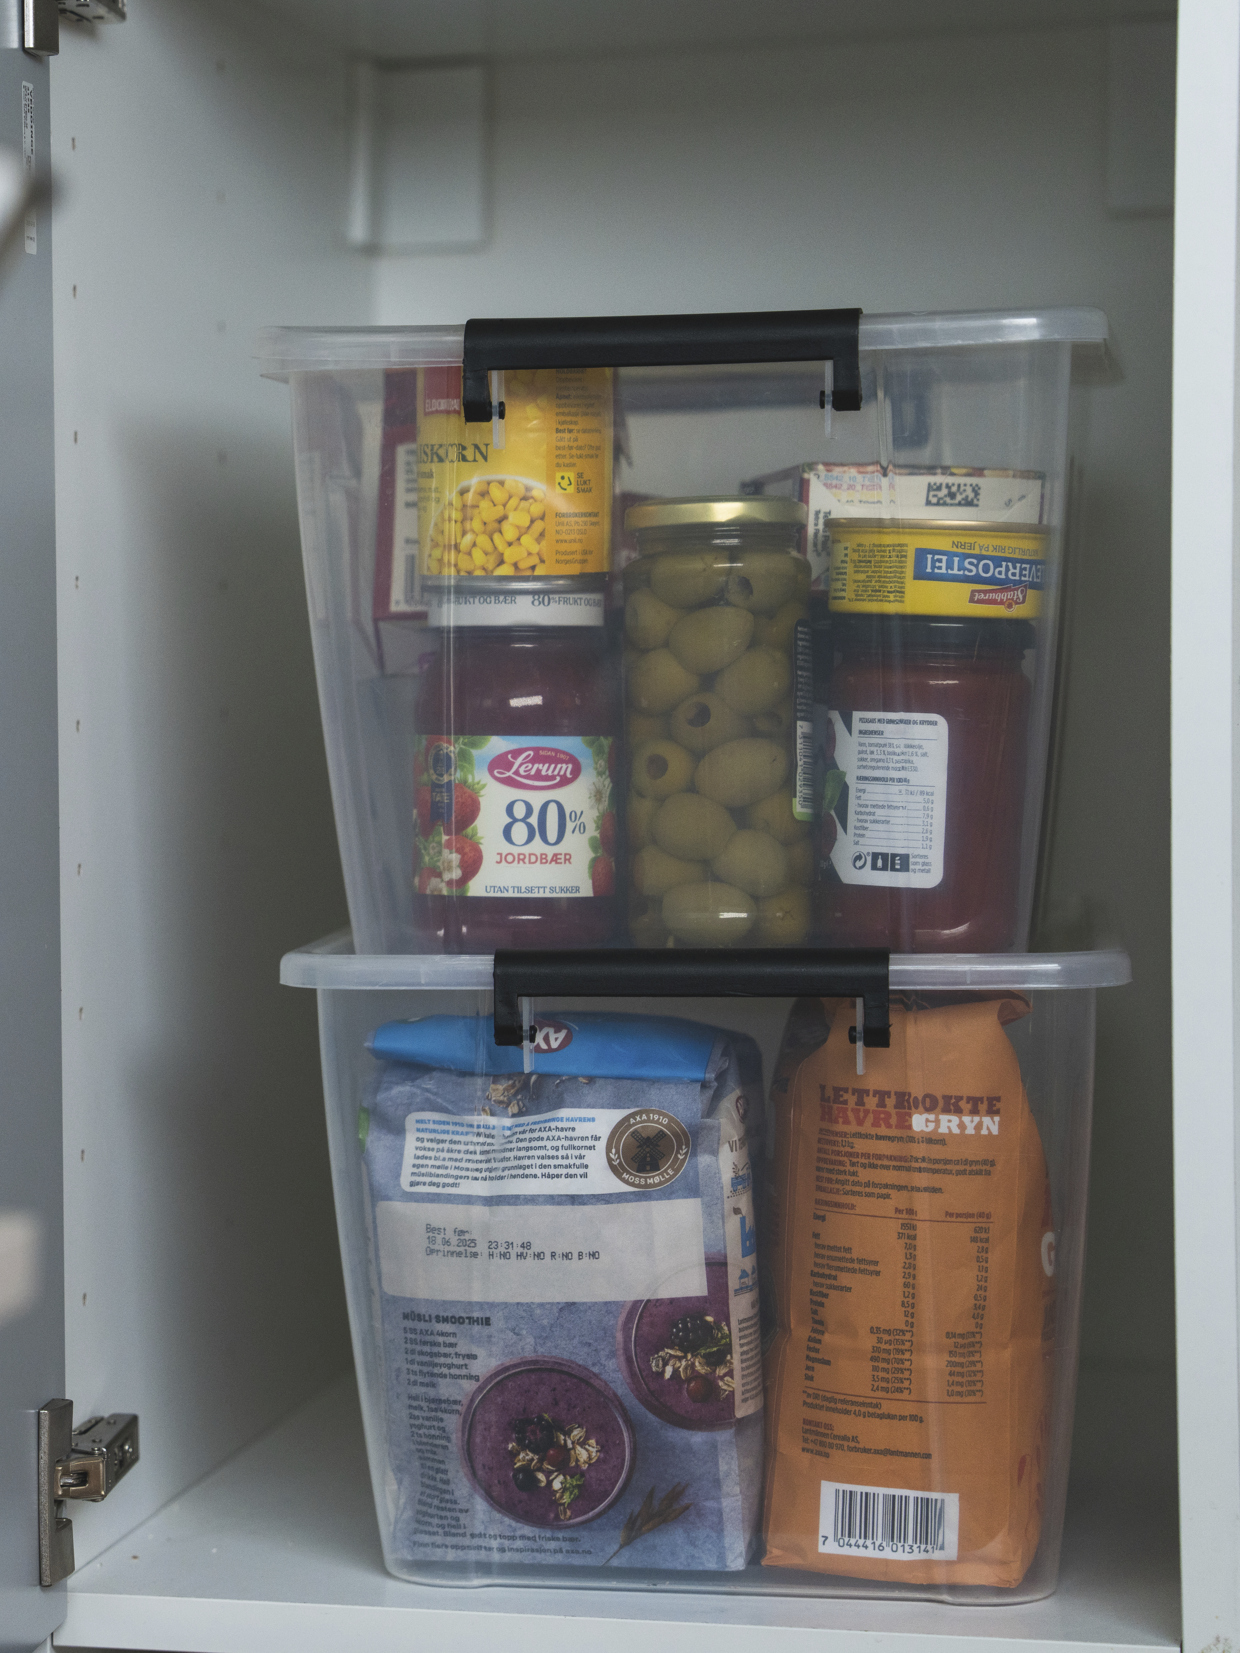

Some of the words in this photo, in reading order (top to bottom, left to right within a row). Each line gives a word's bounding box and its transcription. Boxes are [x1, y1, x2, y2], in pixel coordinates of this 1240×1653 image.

[951, 540, 977, 551] JERN
[978, 543, 990, 555] PÅ
[991, 544, 1007, 555] RIK
[973, 586, 1026, 603] Stabburet
[479, 596, 492, 605] OG
[493, 595, 517, 605] BÆR
[557, 597, 584, 606] FRUKT
[556, 752, 570, 761] 1907
[494, 750, 573, 787] Lerum
[495, 852, 573, 865] JORDBÆR
[485, 885, 510, 894] UTAN
[511, 886, 548, 895] TILSETT
[549, 886, 581, 895] SUKKER
[630, 1113, 648, 1125] AXA
[649, 1113, 669, 1125] 1910
[537, 1125, 576, 1134] AXA-havre
[416, 1136, 425, 1144] og
[426, 1138, 448, 1146] velger
[528, 1136, 545, 1144] gode
[590, 1134, 602, 1142] får
[436, 1146, 445, 1154] på
[446, 1147, 463, 1155] åkre
[516, 1144, 549, 1153] langsomt,
[550, 1145, 560, 1153] og
[561, 1143, 597, 1151] fullkornet
[513, 1153, 536, 1161] Havren
[560, 1152, 570, 1160] så
[574, 1152, 586, 1160] vår
[412, 1163, 429, 1171] egen
[538, 1161, 551, 1169] den
[553, 1161, 589, 1170] smakfulle
[541, 1171, 563, 1180] Håper
[564, 1171, 578, 1179] den
[579, 1171, 588, 1179] vil
[621, 1171, 646, 1185] MOSS
[646, 1167, 675, 1185] MØLLE
[409, 1180, 427, 1188] gjøre
[441, 1181, 461, 1189] godt!
[842, 1188, 864, 1198] Sorteres
[865, 1190, 876, 1198] som
[895, 1207, 905, 1215] Per
[425, 1223, 447, 1236] Best
[453, 1226, 473, 1238] før:
[897, 1231, 906, 1240] 371
[427, 1236, 477, 1249] 18.06.2025
[487, 1240, 532, 1251] 23:31:48
[488, 1251, 511, 1261] H:NO
[516, 1251, 546, 1261] HV:NO
[550, 1251, 573, 1261] R:NO
[577, 1251, 601, 1261] B:NO
[903, 1281, 911, 1290] 60
[402, 1311, 432, 1323] MÜSLI
[434, 1315, 492, 1327] SMOOTHIE
[419, 1329, 435, 1337] AXA
[436, 1330, 457, 1338] 4korn
[442, 1341, 458, 1349] bær
[448, 1373, 480, 1382] honning
[871, 1383, 880, 1393] 2,4
[423, 1433, 452, 1443] honning
[499, 1533, 517, 1543] topp
[518, 1533, 537, 1542] med
[821, 1535, 829, 1546] 7
[838, 1537, 885, 1552] 044416
[891, 1542, 936, 1554] 013141
